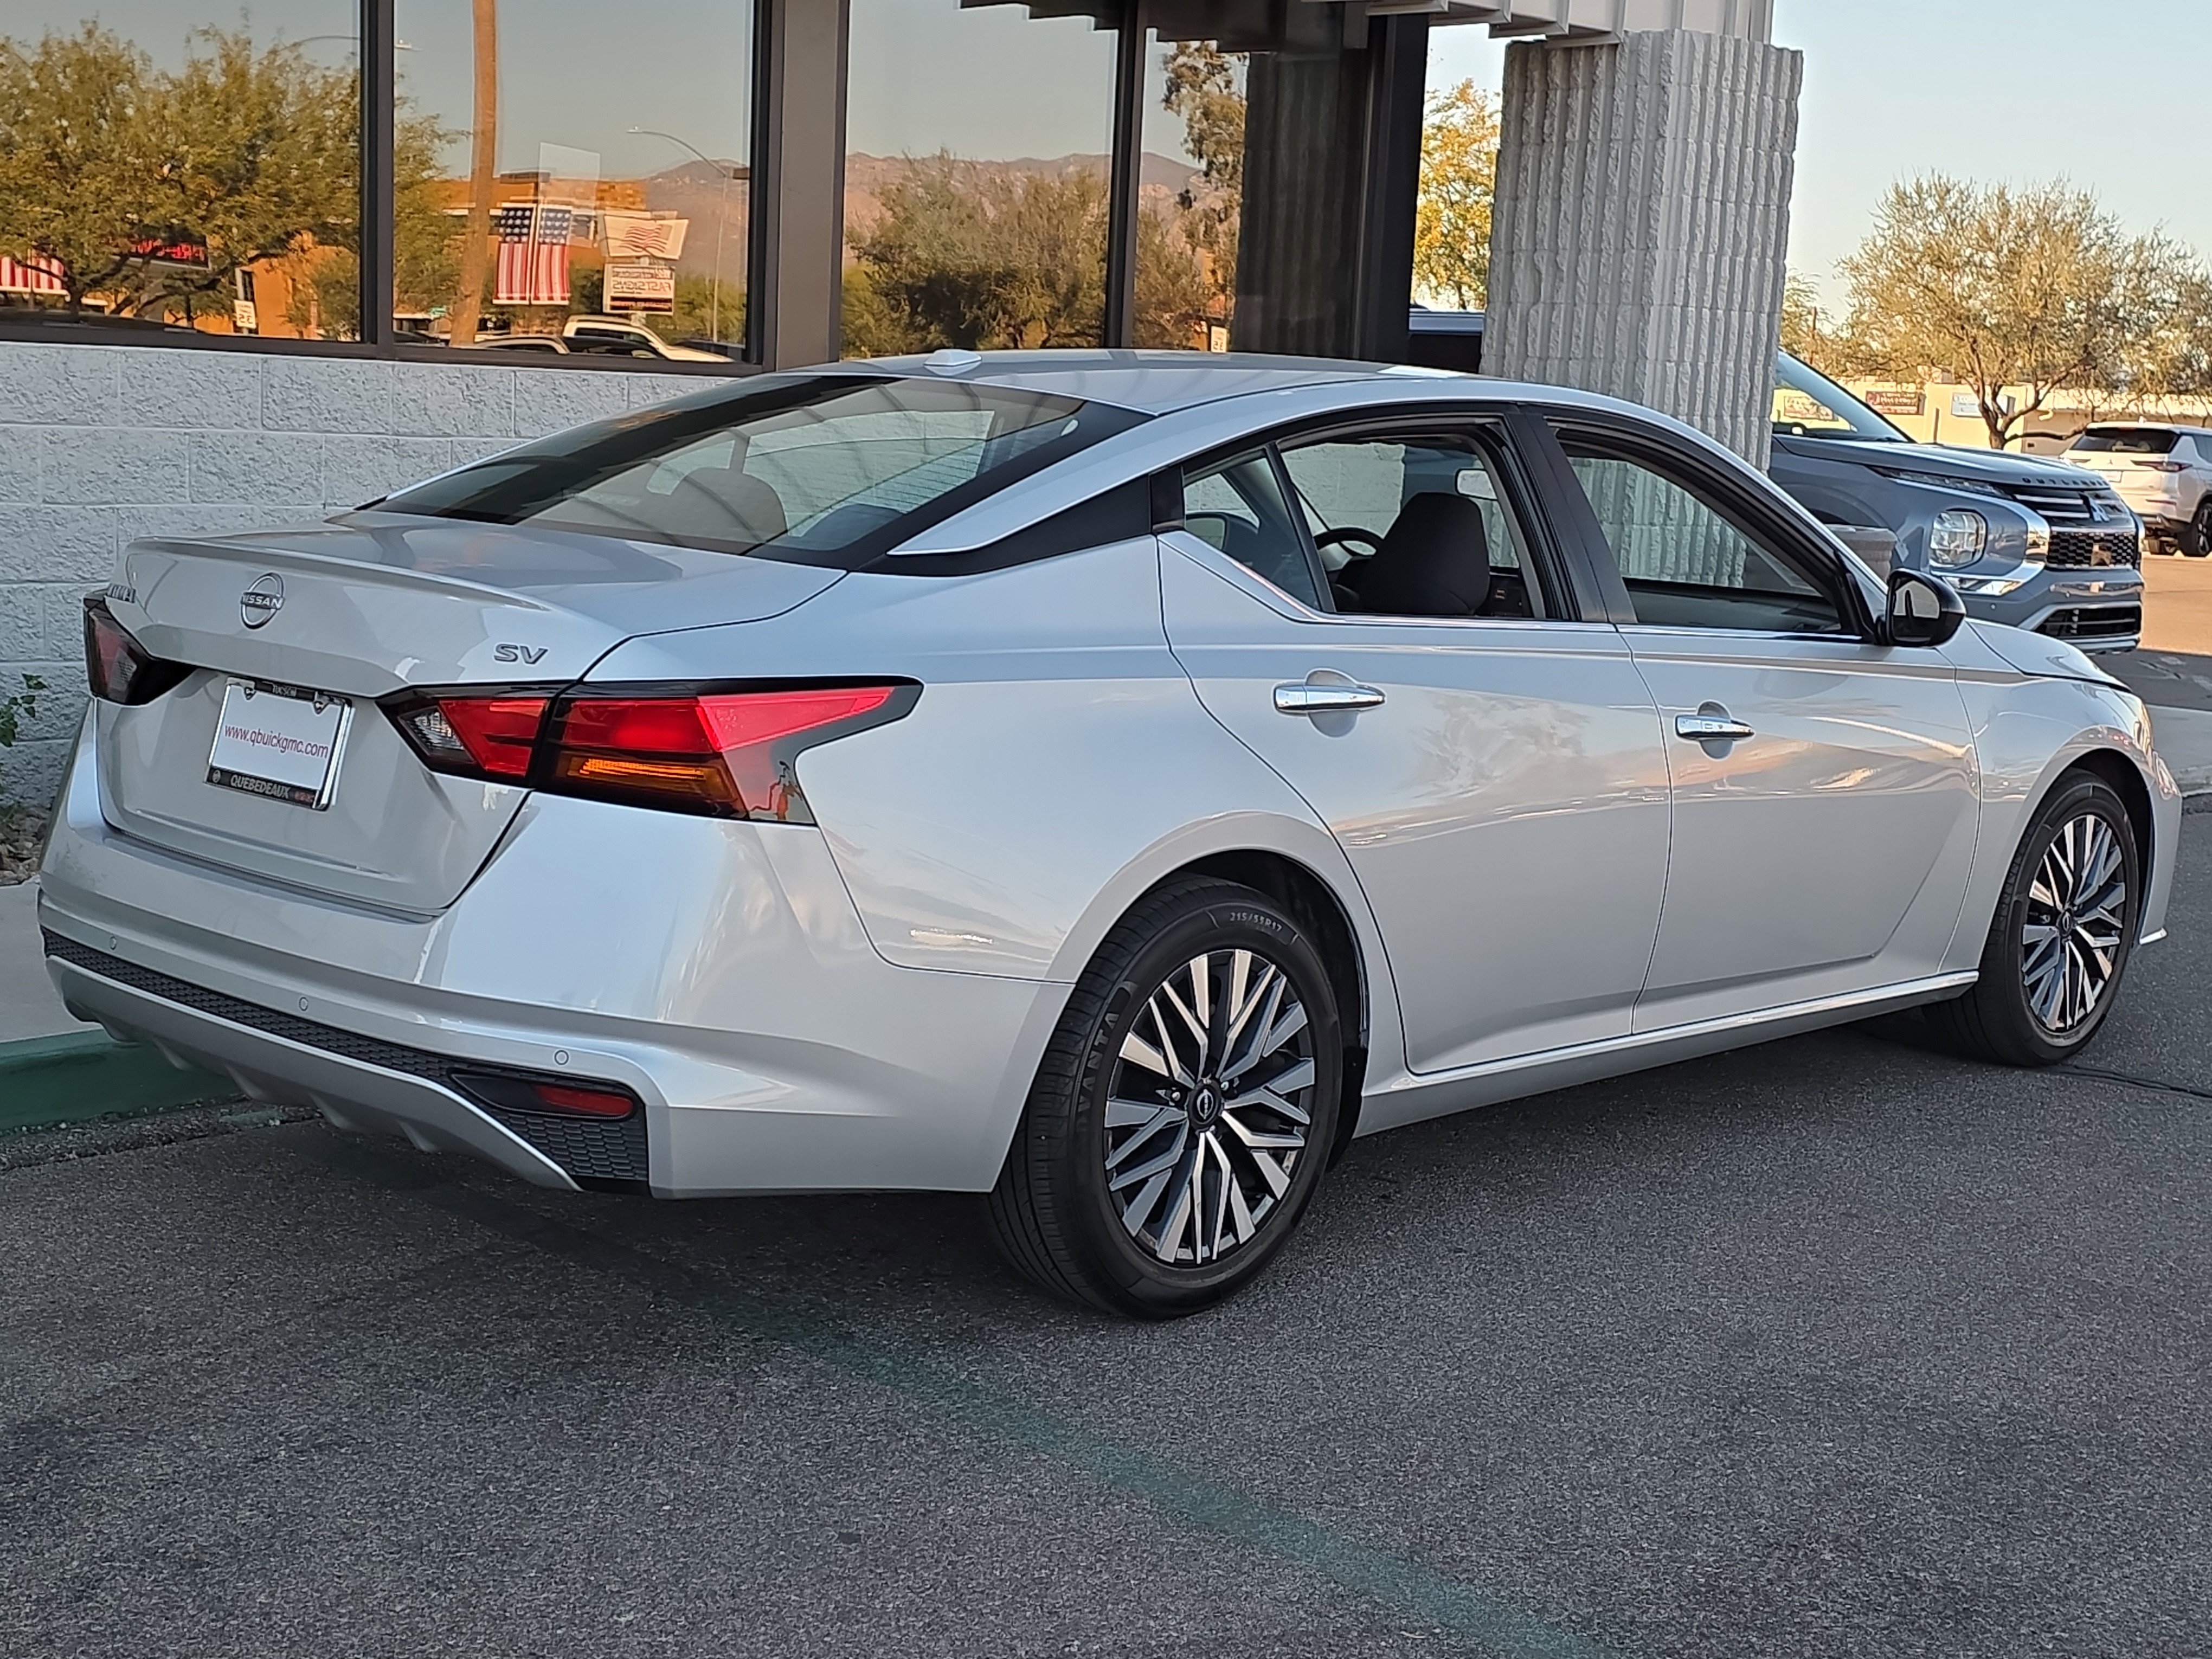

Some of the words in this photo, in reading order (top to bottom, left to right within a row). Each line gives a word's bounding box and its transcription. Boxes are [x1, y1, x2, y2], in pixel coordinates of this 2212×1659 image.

[494, 644, 548, 664] SV
[224, 725, 329, 759] www.qbuickgmc.com
[230, 774, 291, 799] QUEBEDEAUX
